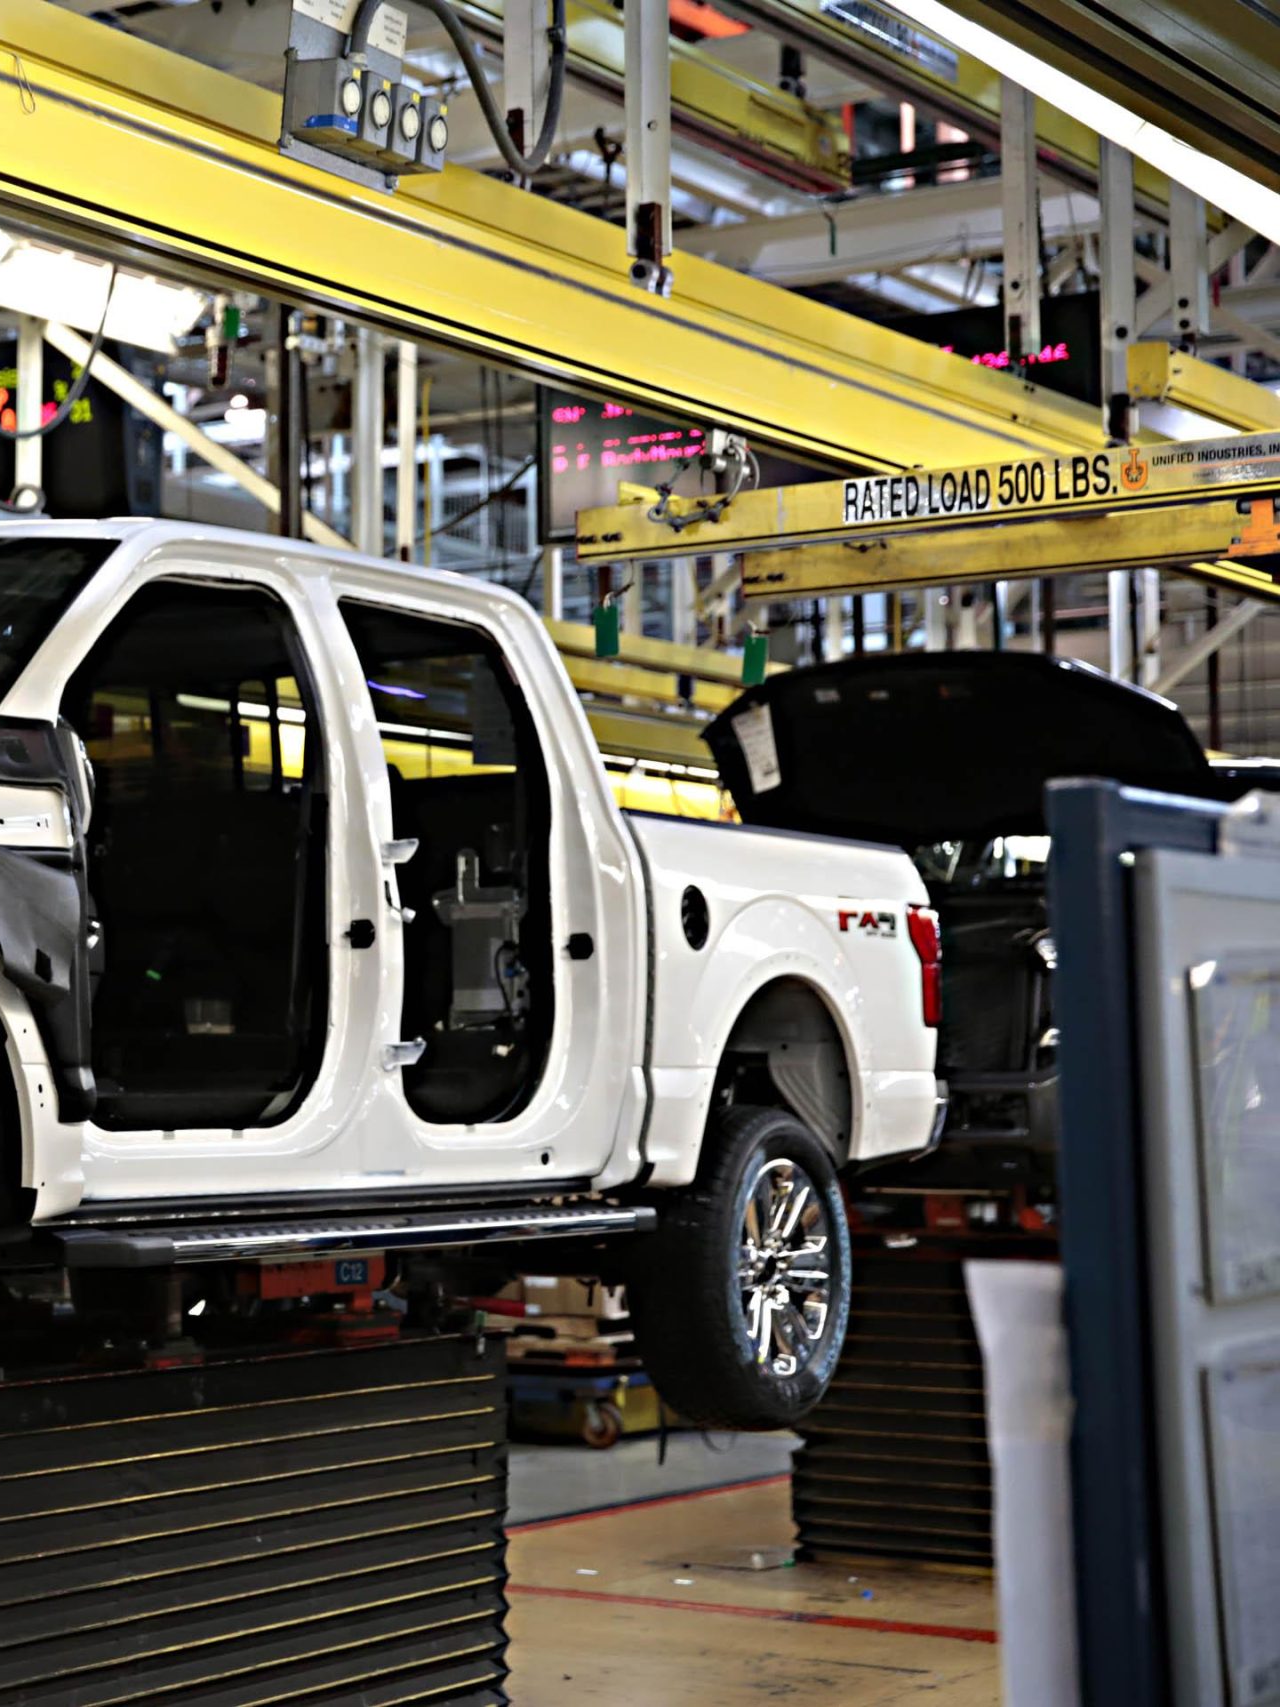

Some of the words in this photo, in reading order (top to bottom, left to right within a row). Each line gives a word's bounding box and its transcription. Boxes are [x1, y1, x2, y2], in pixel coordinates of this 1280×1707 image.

[1152, 451, 1194, 467] UNIFIED
[1197, 444, 1267, 464] INDUSTRIES,
[845, 476, 919, 522] RATED
[928, 469, 990, 514] LOAD
[998, 462, 1045, 506] 500
[1055, 454, 1118, 500] LBS.
[340, 1262, 363, 1282] C12
